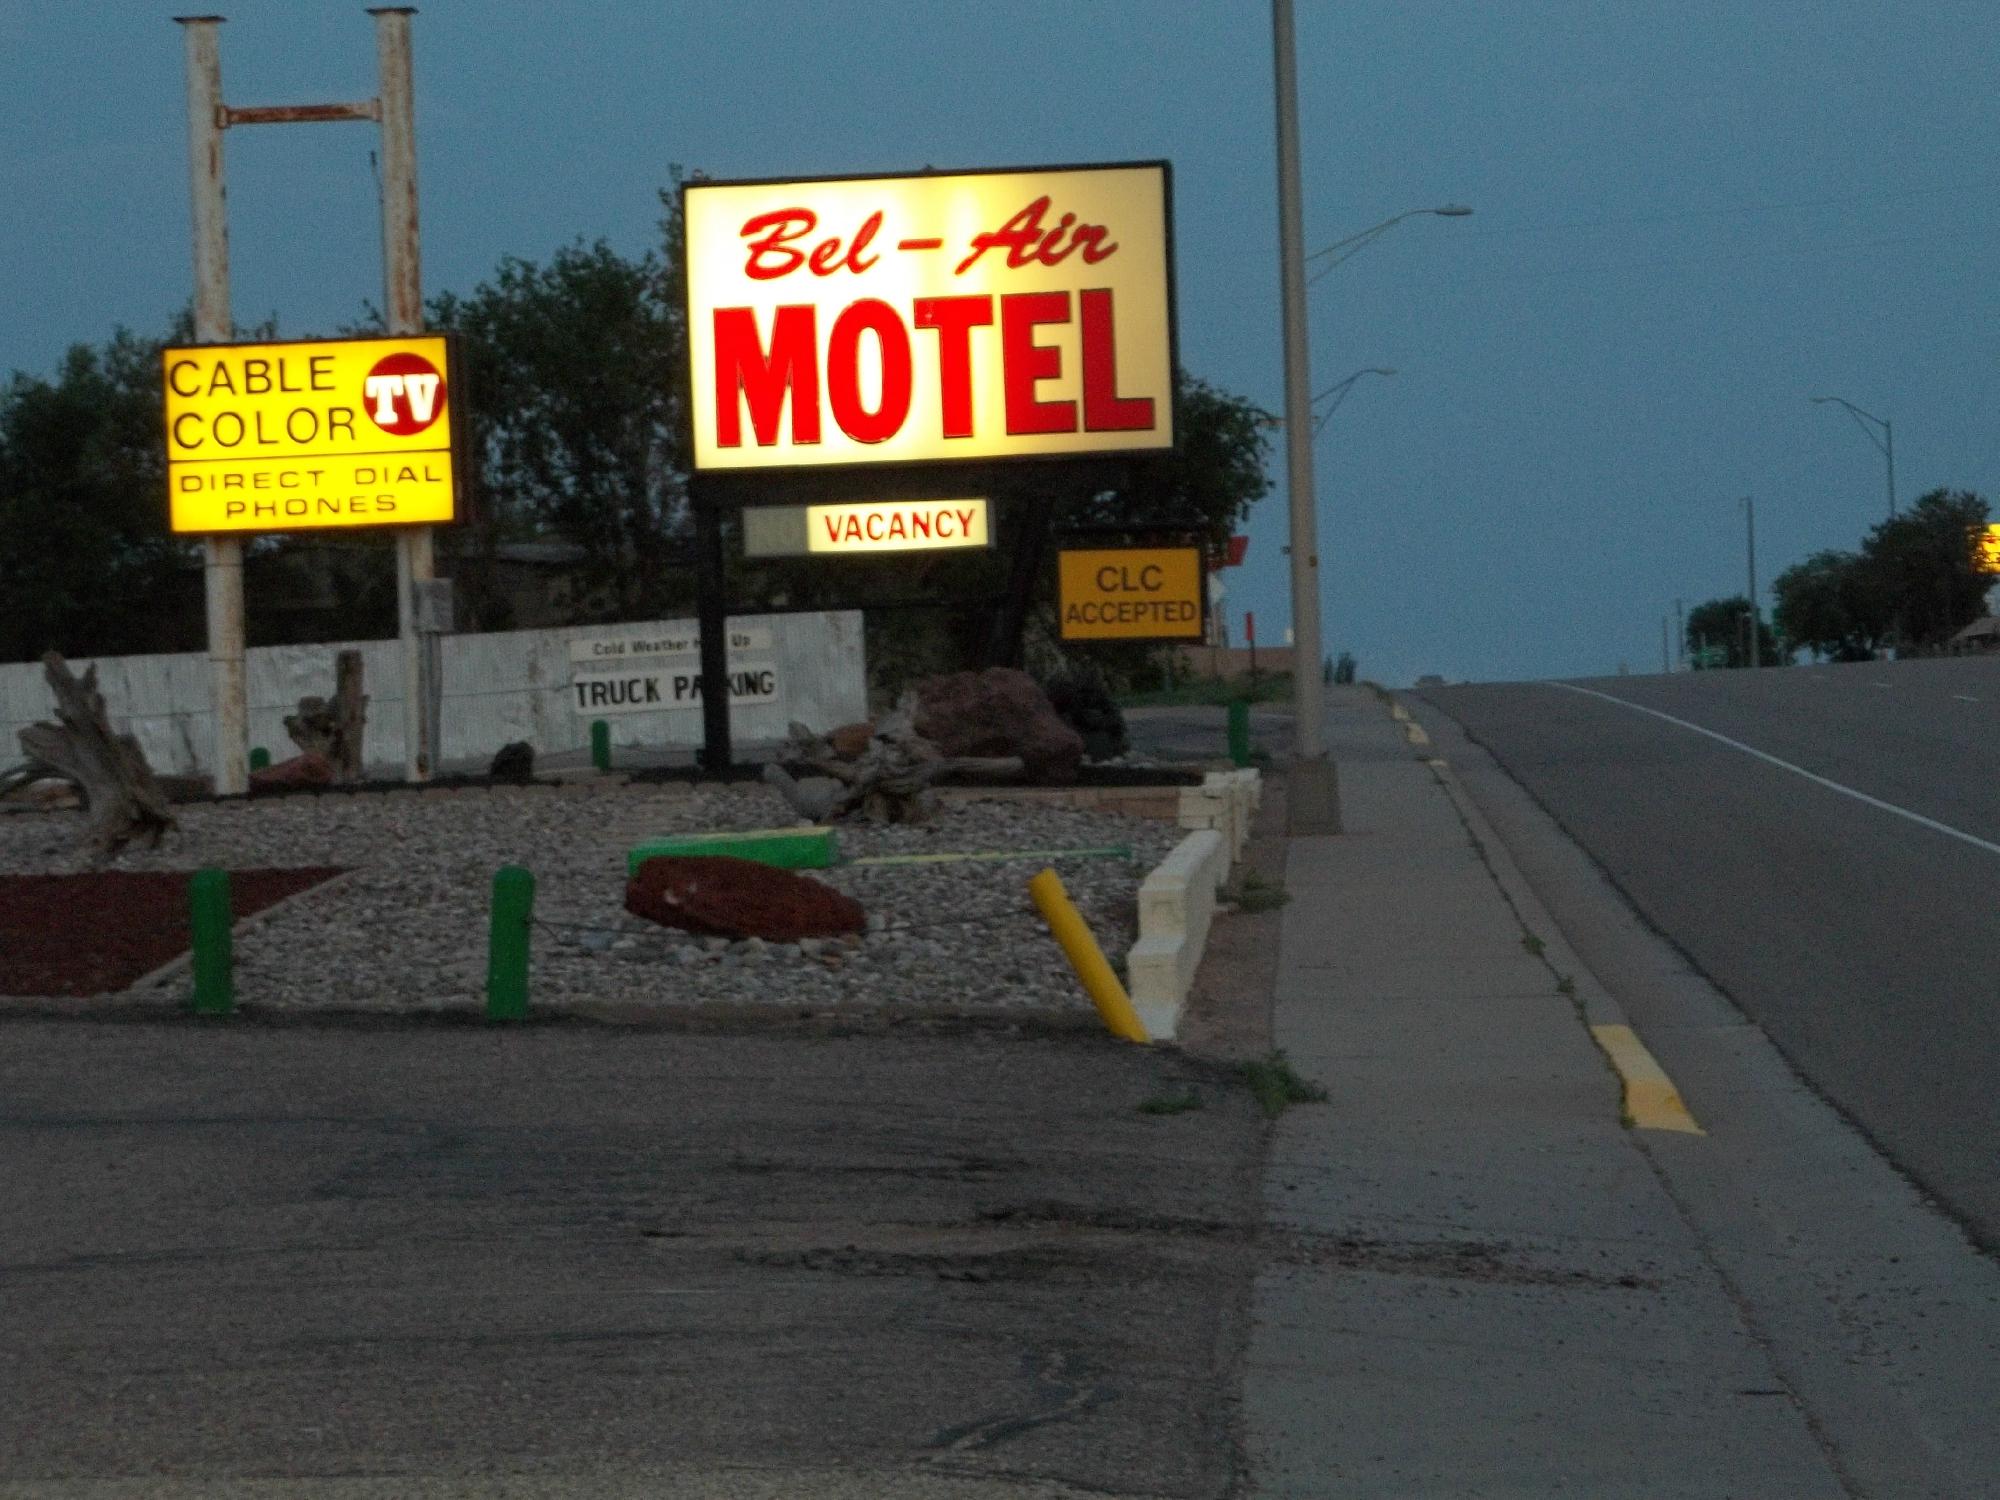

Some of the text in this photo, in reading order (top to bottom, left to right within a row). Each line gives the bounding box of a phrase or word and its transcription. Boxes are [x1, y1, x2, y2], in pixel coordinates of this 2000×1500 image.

[169, 356, 336, 397] CABLE
[713, 287, 1156, 449] MOTEL
[365, 373, 439, 424] TV
[173, 407, 356, 450] COLOR
[180, 465, 443, 493] DIRECT DIAL
[226, 494, 397, 519] PHONES
[824, 508, 976, 543] VACANCY
[1096, 564, 1163, 592] CLC
[1065, 600, 1198, 624] ACCEPTED
[592, 639, 625, 656] Cold
[632, 637, 689, 654] Weather
[731, 633, 751, 648] Up
[575, 670, 776, 708] TRUCK PAKING
